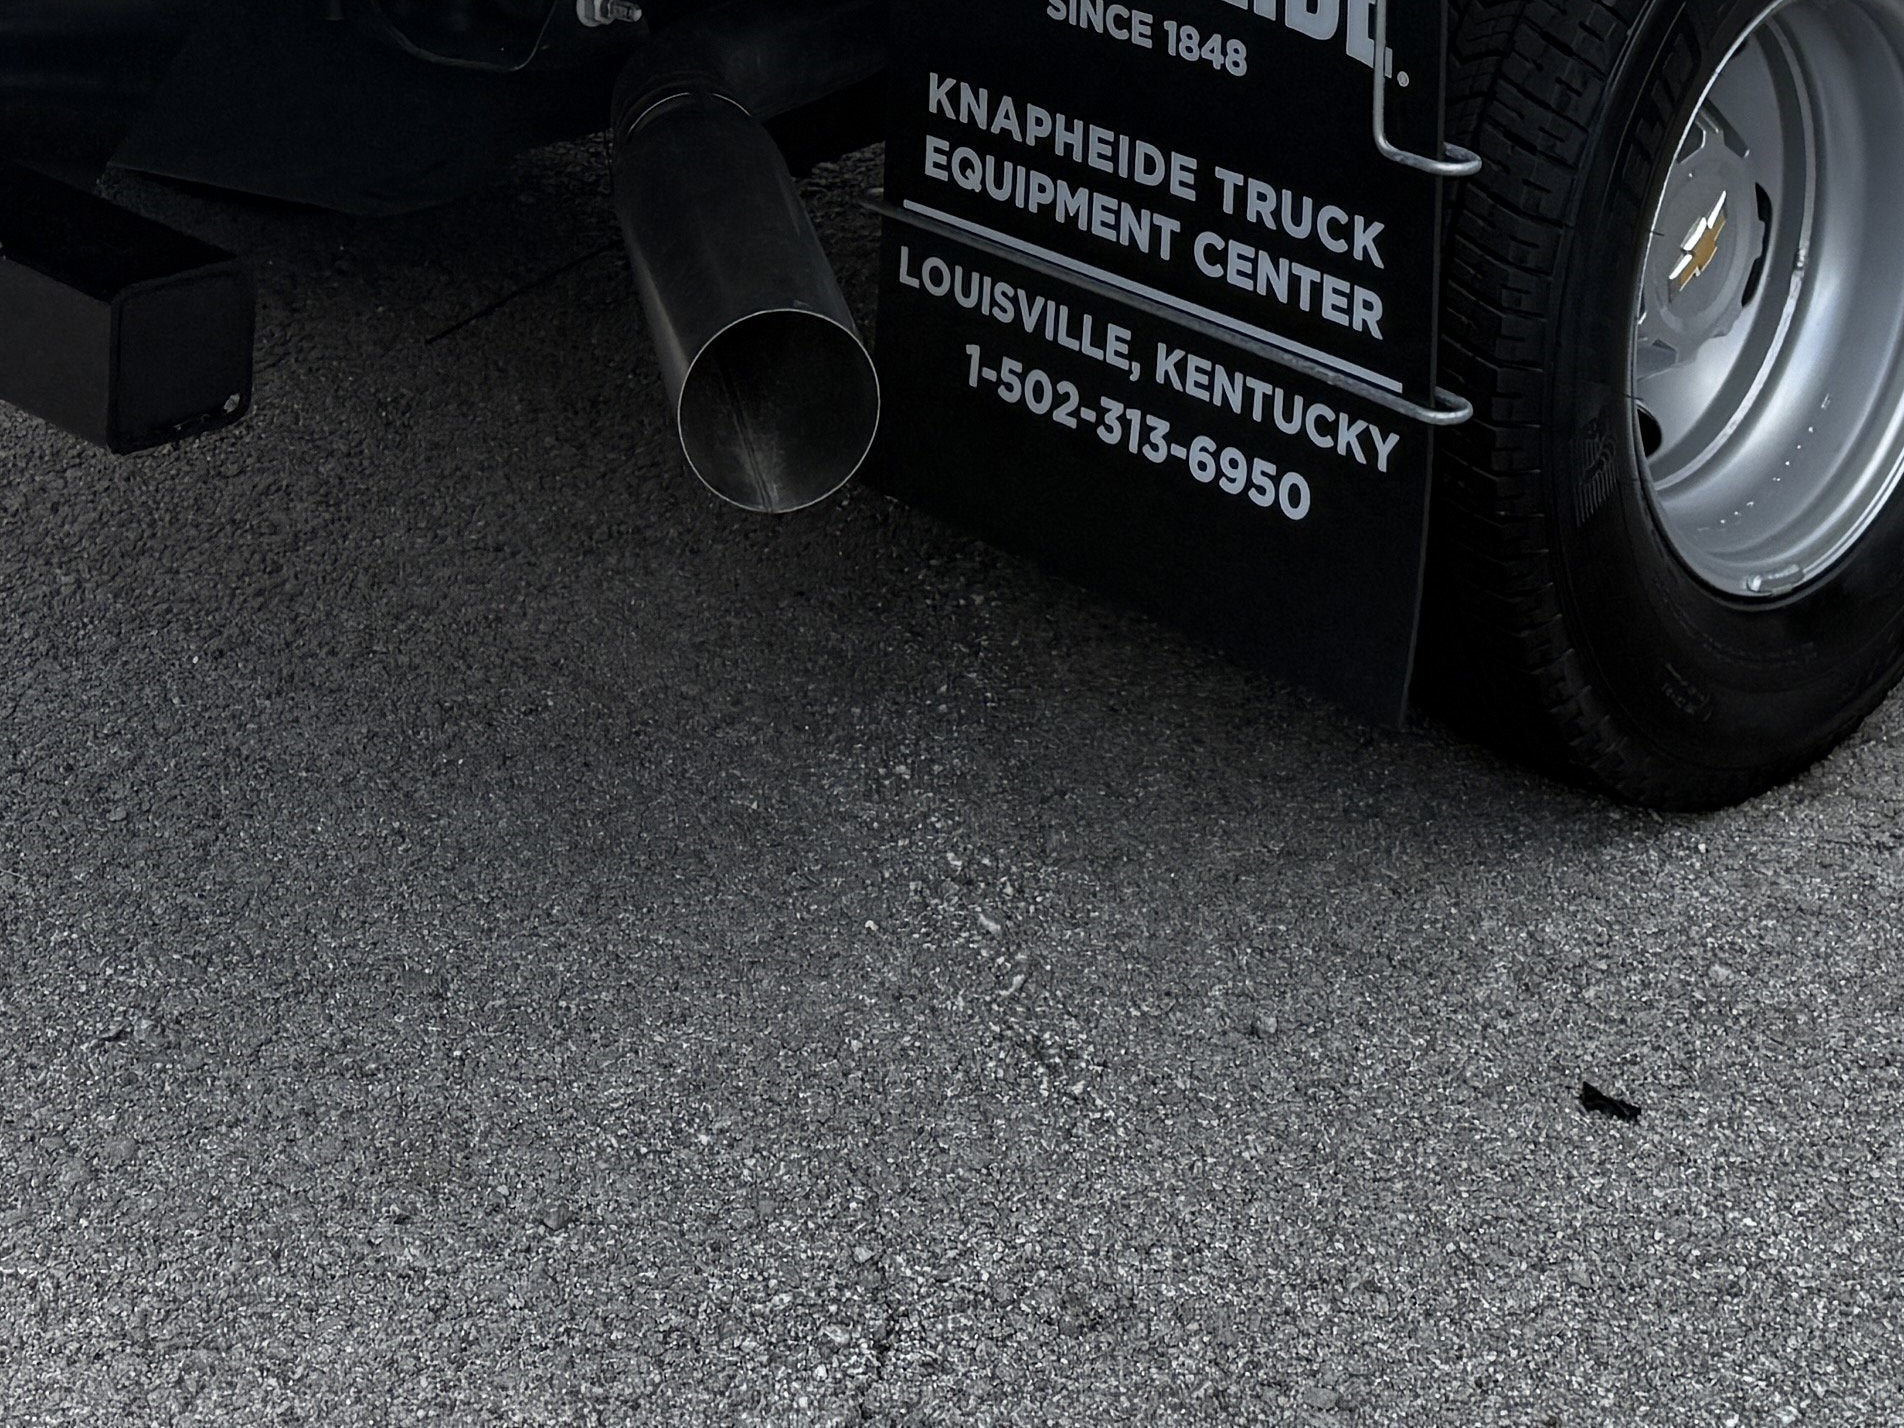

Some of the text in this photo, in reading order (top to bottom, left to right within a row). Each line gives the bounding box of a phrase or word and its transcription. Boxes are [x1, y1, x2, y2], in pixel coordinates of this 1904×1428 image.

[1163, 19, 1249, 78] 1848
[923, 135, 1384, 339] EQUIPMENT CENTER
[927, 72, 1385, 269] KNAPHEIDE TRUCK
[900, 246, 1400, 472] LOUISVILLE, KENTUCKY
[966, 343, 1312, 521] 1-502-313-6950
